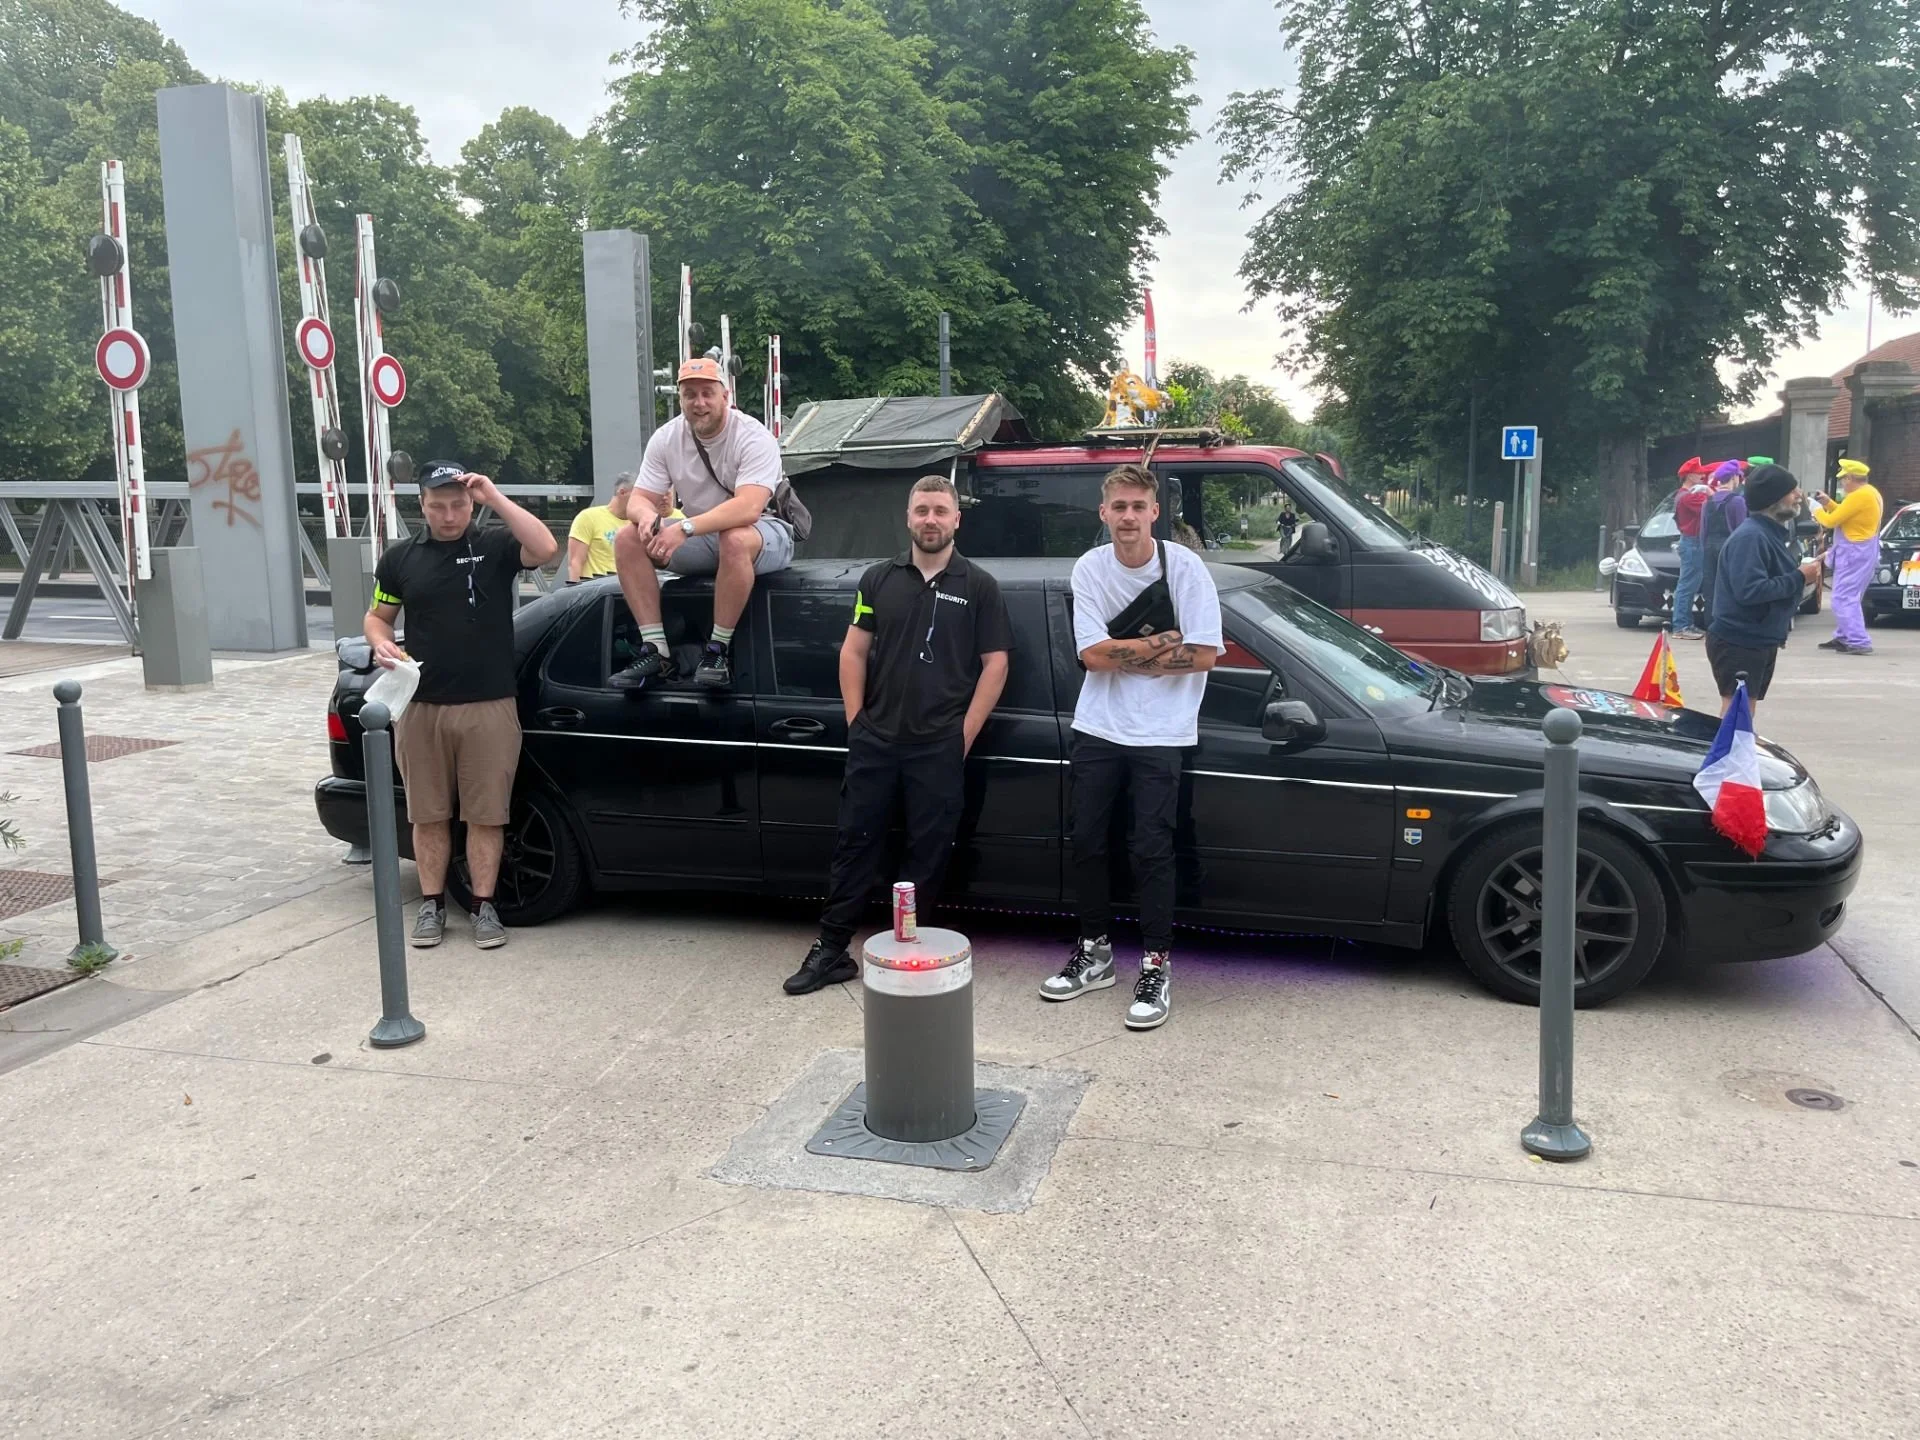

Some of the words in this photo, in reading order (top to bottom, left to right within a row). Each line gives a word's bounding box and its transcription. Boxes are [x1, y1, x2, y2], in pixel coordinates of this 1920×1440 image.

[431, 467, 465, 479] SECURITY
[456, 555, 485, 565] SECRIT
[936, 592, 968, 605] SECURITY
